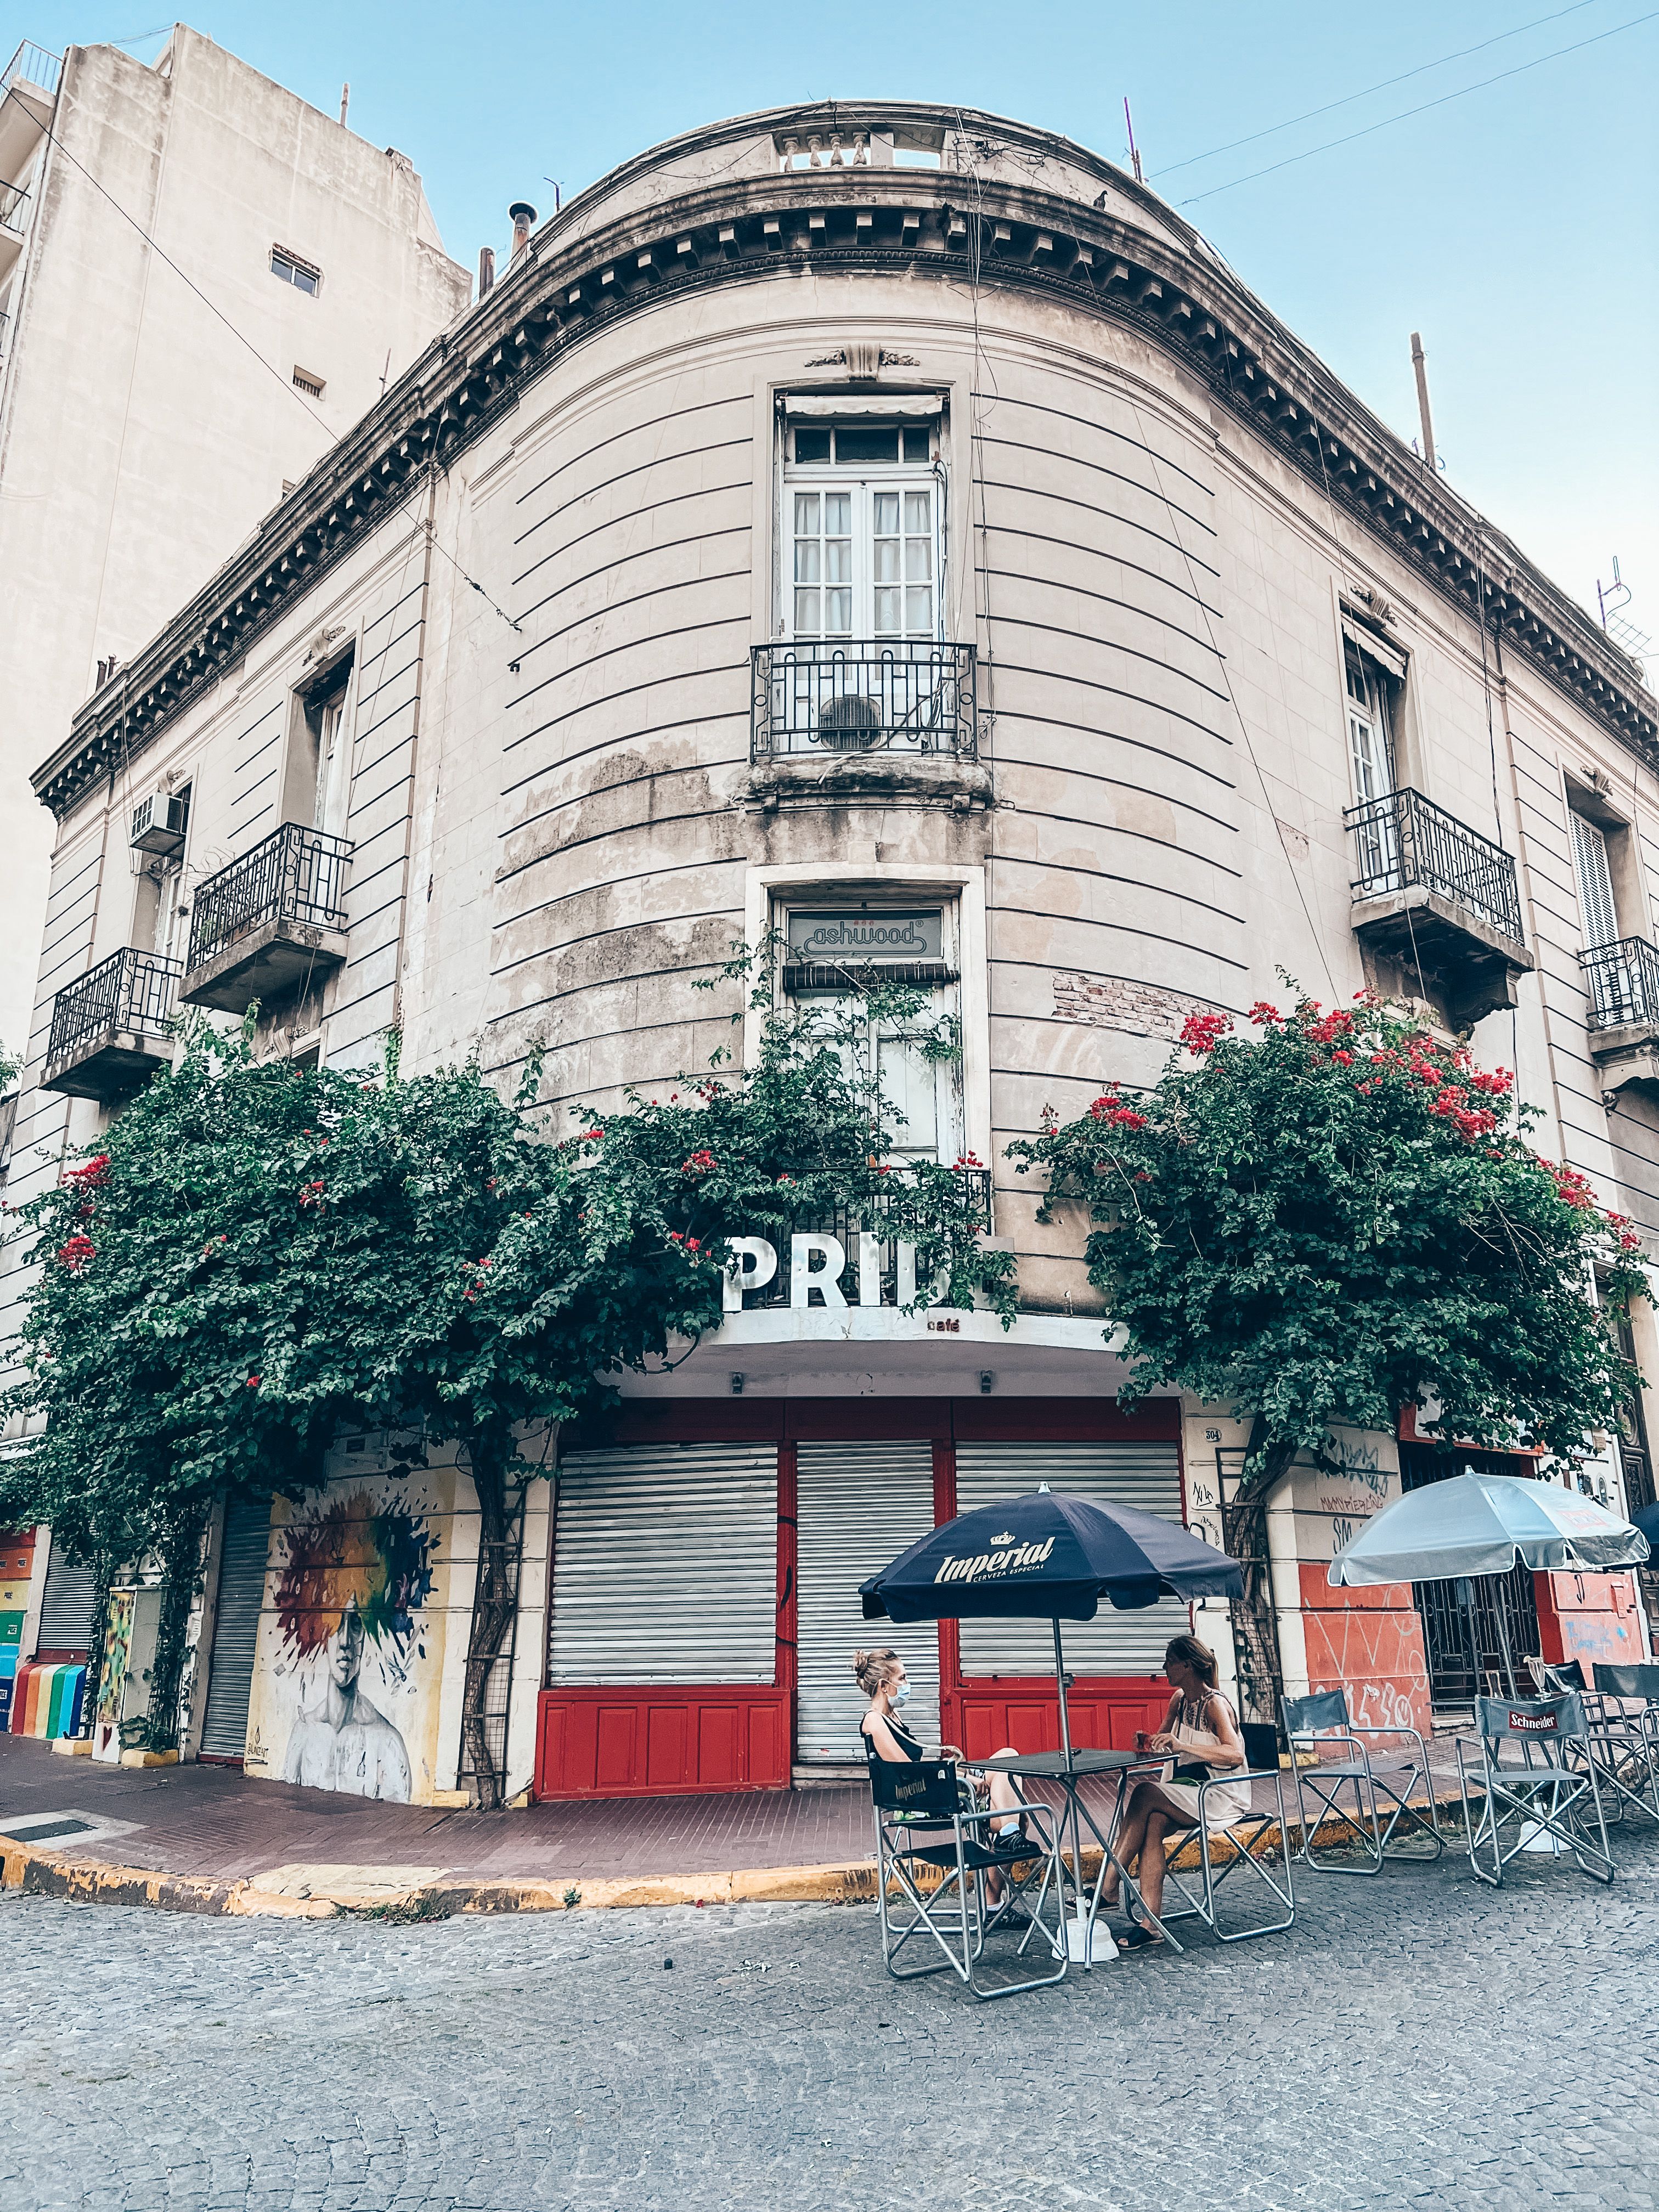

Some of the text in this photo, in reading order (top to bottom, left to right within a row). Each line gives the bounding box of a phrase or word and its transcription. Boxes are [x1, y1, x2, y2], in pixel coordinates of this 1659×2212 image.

[927, 1318, 960, 1332] café
[1205, 1430, 1220, 1440] 304
[934, 1536, 1056, 1584] Imperial
[973, 1565, 1044, 1583] CERVEZA ESPECIAL
[1511, 1714, 1555, 1729] Schneider
[895, 1778, 926, 1801] Imperial
